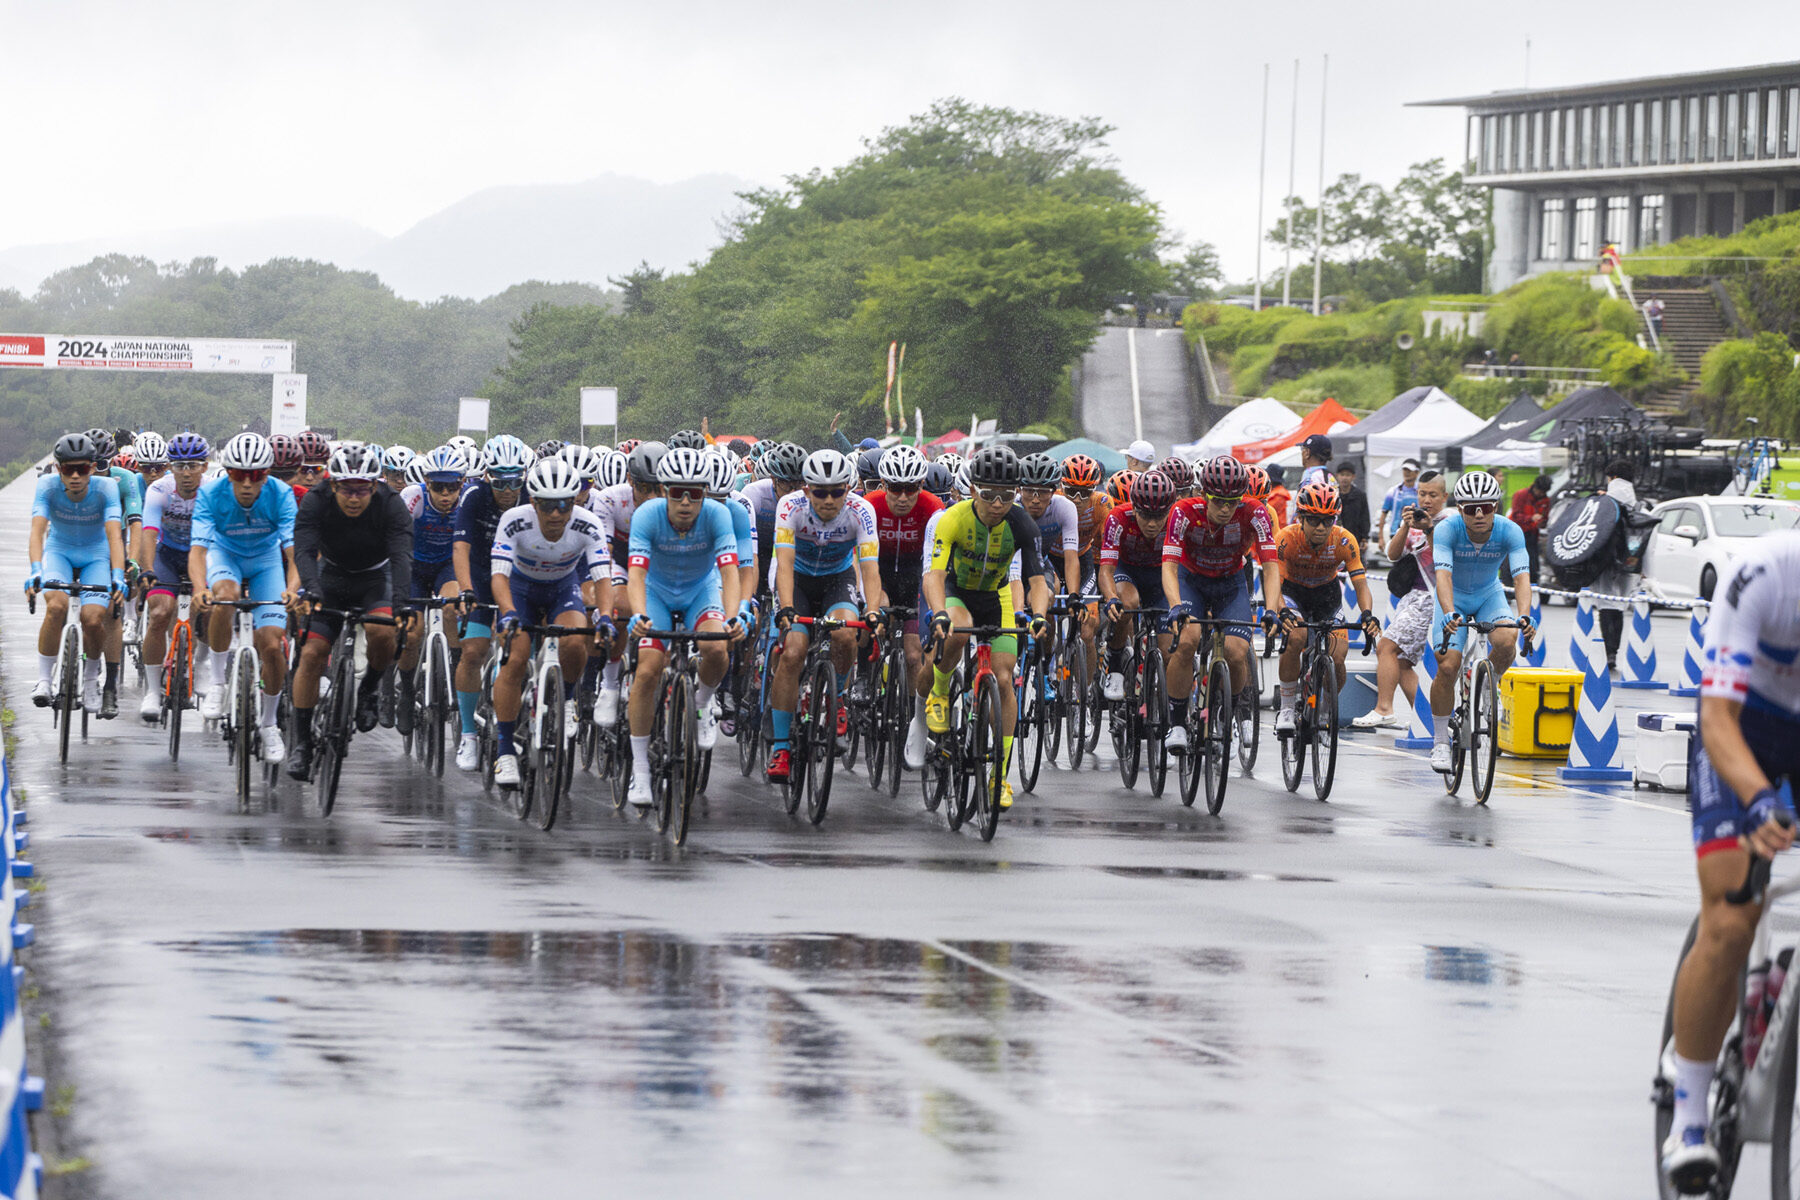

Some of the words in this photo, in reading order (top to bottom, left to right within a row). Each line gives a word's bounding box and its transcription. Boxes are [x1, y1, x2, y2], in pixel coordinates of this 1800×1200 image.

[58, 341, 108, 358] 2024
[111, 341, 142, 350] JAPAN
[145, 342, 192, 351] NATIONAL
[110, 350, 193, 360] CHAMPIONSHIPS
[879, 529, 918, 540] FORCE
[1553, 531, 1598, 560] CAMPAGNOLO
[1455, 550, 1501, 559] SHIMANO
